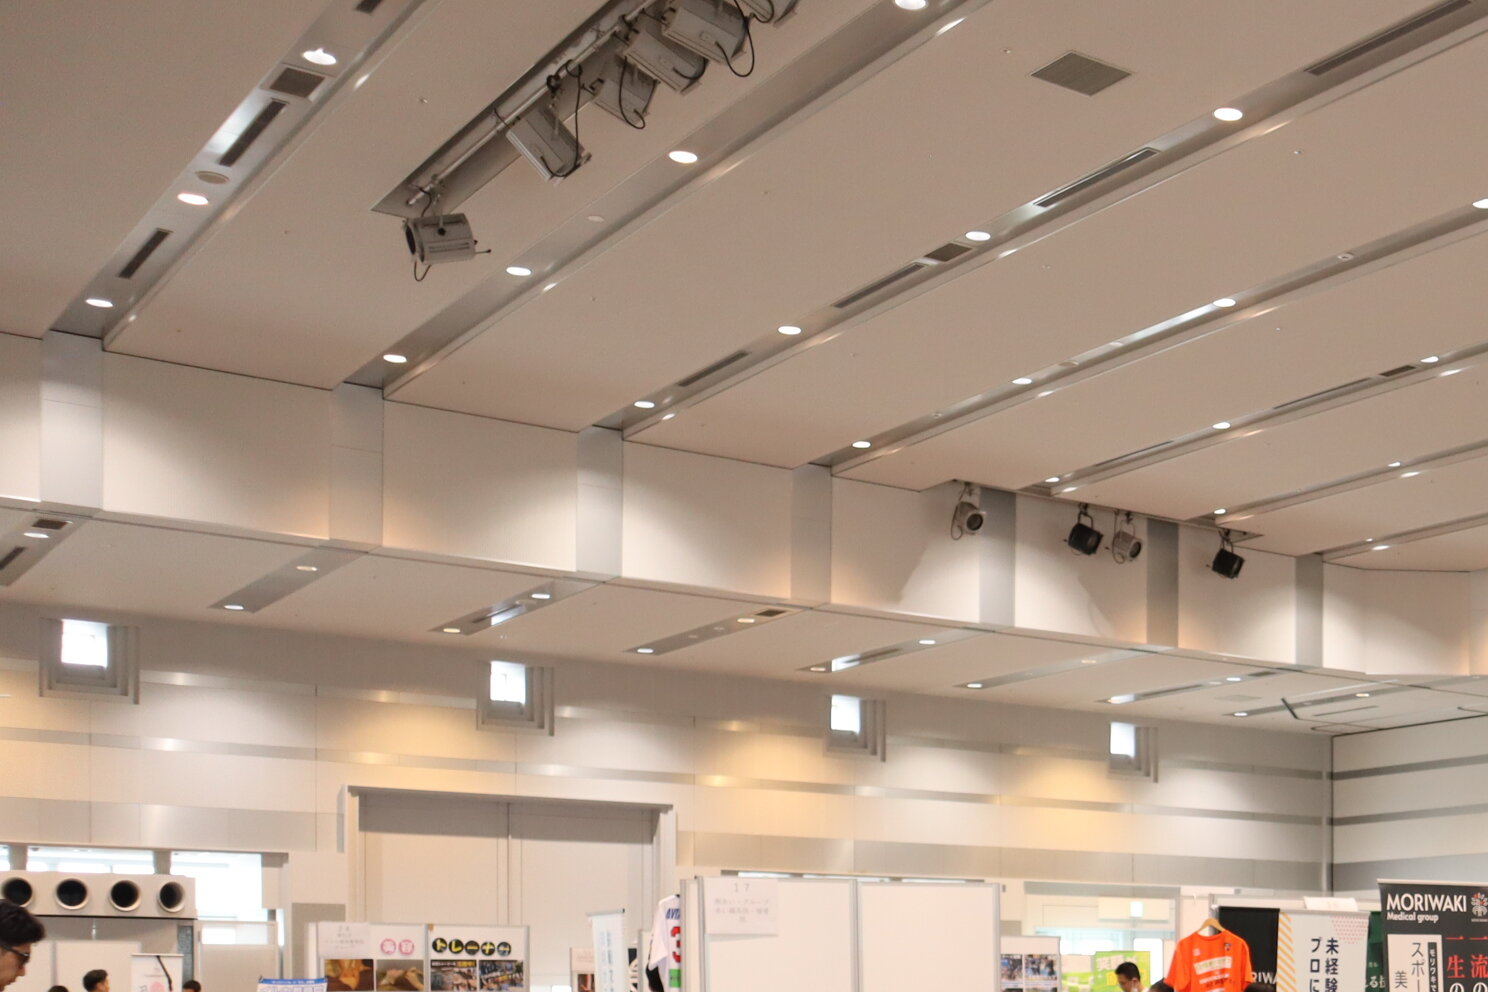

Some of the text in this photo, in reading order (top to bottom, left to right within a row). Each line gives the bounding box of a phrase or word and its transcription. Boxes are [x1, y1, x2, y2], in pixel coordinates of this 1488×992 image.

[1386, 893, 1467, 912] MORIWAKI
[1387, 912, 1439, 923] Medical group
